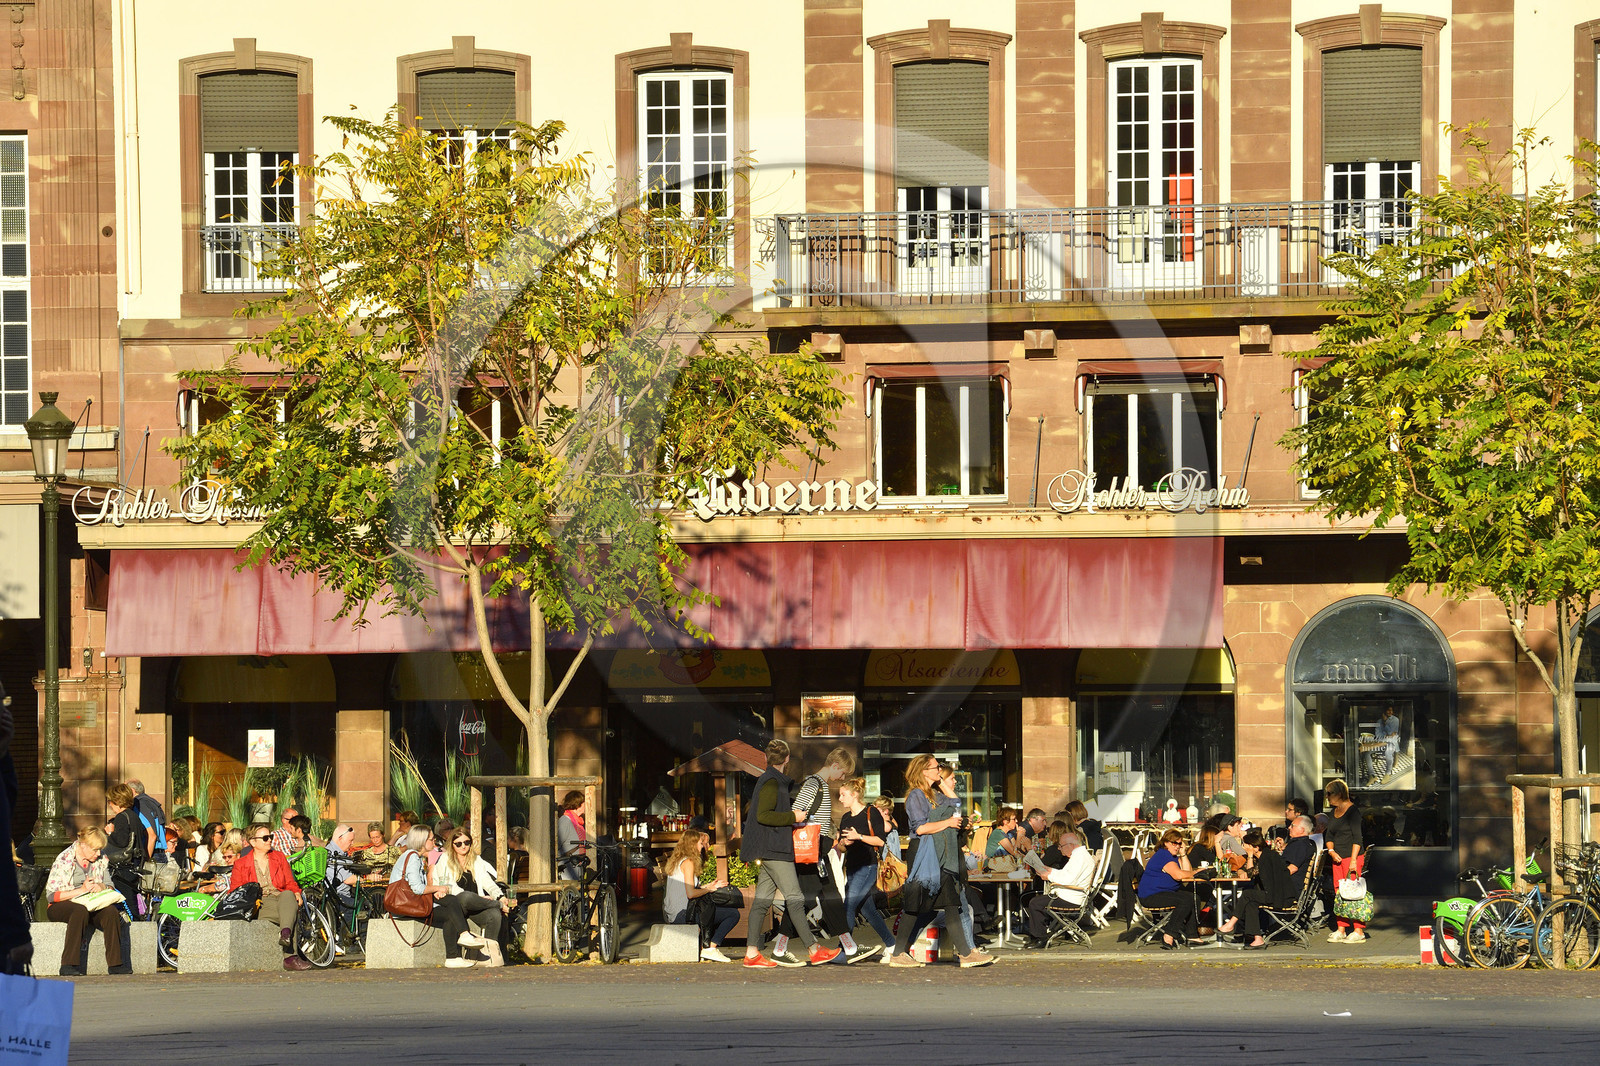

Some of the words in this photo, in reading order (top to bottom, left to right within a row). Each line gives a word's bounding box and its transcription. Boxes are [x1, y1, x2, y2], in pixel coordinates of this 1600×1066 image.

[686, 464, 878, 523] Taverne
[1156, 467, 1250, 514] Rehm
[875, 652, 1010, 683] Alsacienne
[1322, 653, 1418, 681] minelli
[8, 1035, 52, 1049] HALLE
